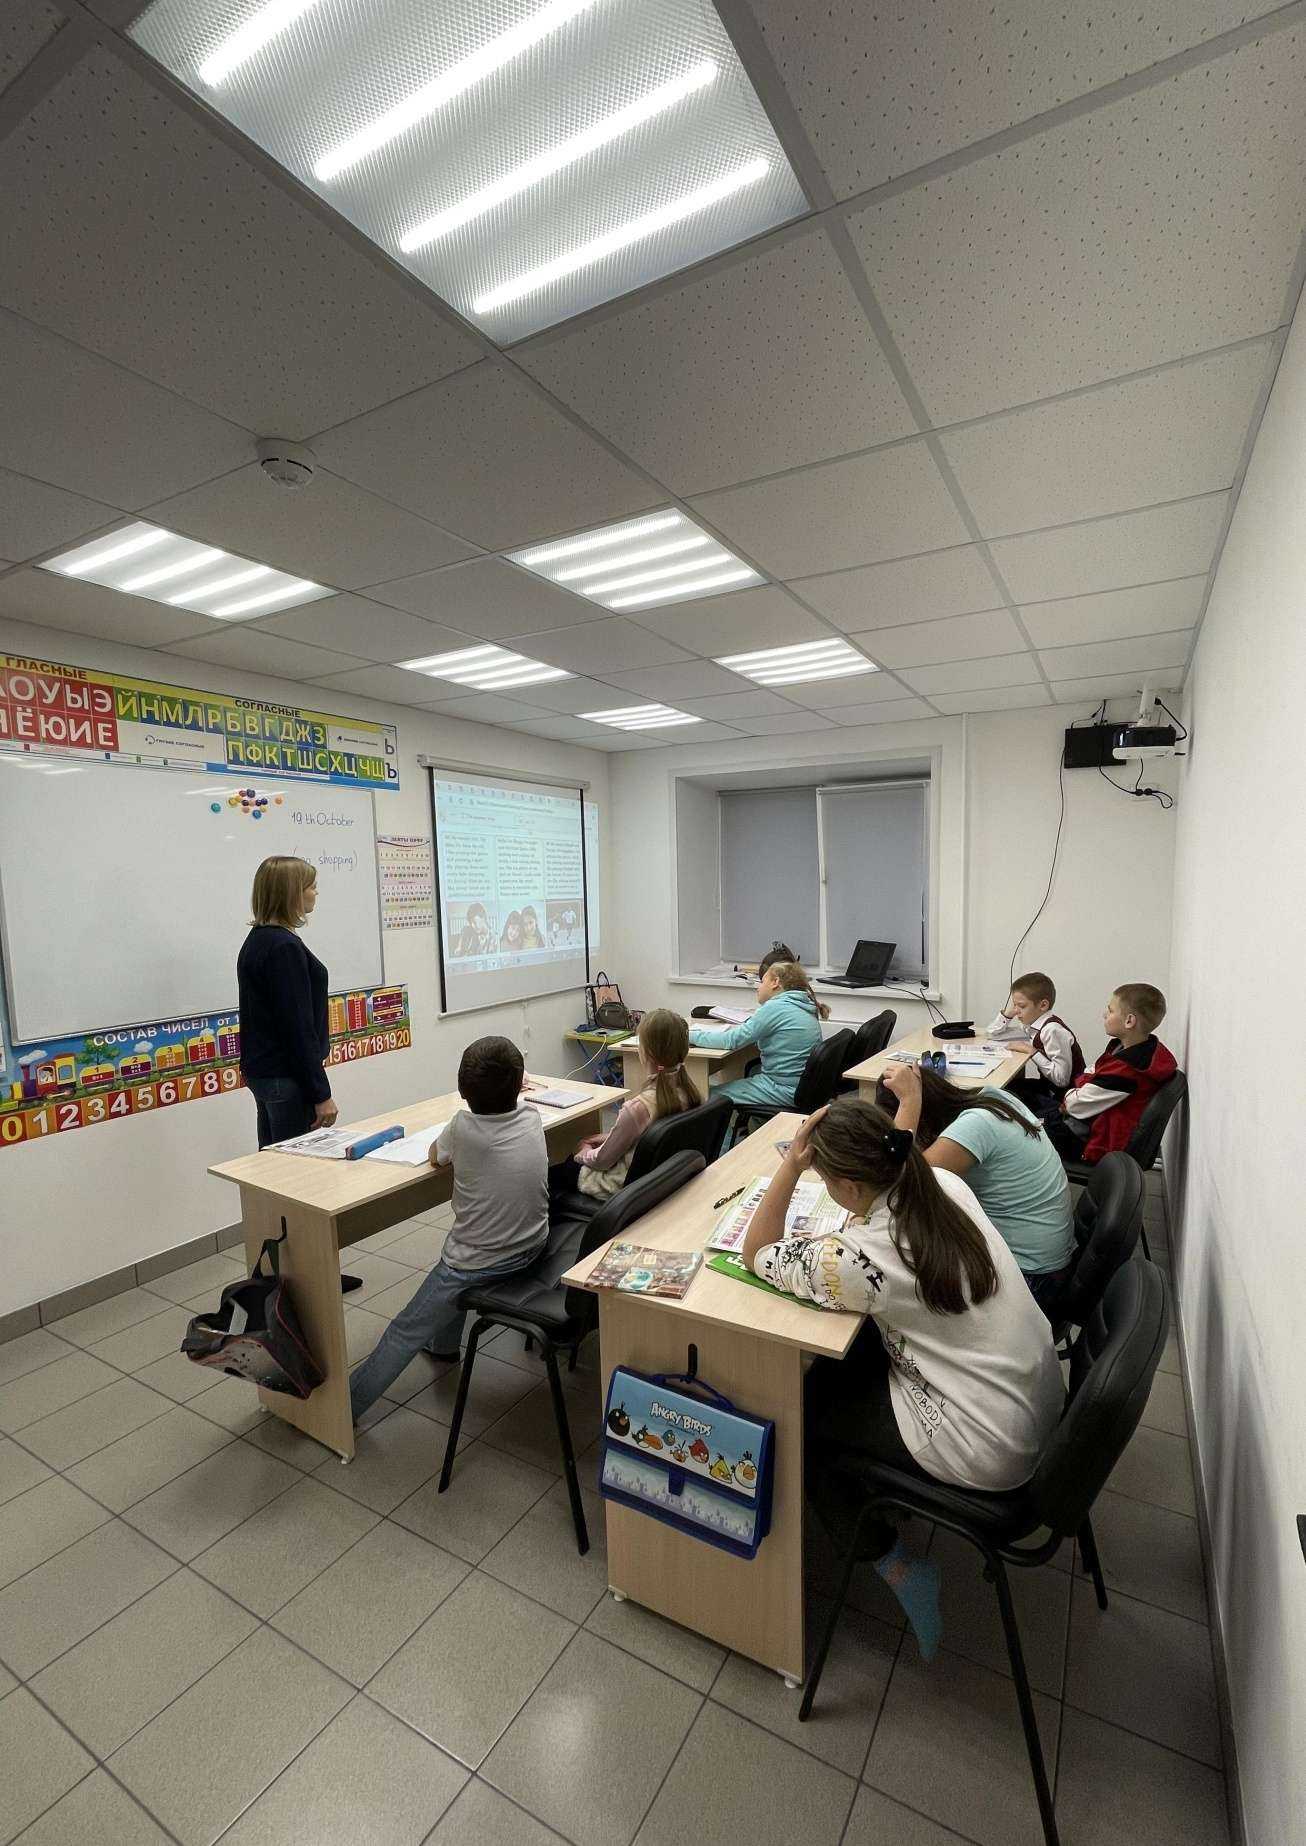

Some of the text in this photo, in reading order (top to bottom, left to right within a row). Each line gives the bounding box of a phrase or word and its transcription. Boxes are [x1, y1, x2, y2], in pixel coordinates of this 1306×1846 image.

[5, 656, 87, 680] ГЛАСНЫЕ
[234, 699, 301, 718] СОГЛАСНЫЕ
[93, 1027, 158, 1048] СОСТАВ
[162, 1017, 210, 1035] ЧИСЕЛ
[1, 1114, 24, 1142] 0
[32, 1110, 48, 1134] 1
[59, 1104, 81, 1130] 2
[87, 1098, 106, 1123] 3
[110, 1092, 130, 1116] 4
[137, 1087, 154, 1109] 5
[159, 1081, 177, 1104] 6
[182, 1076, 197, 1098] 7
[203, 1071, 219, 1094] 8
[222, 1068, 237, 1089] 9
[650, 1402, 713, 1438] ANGRY BIRDS
